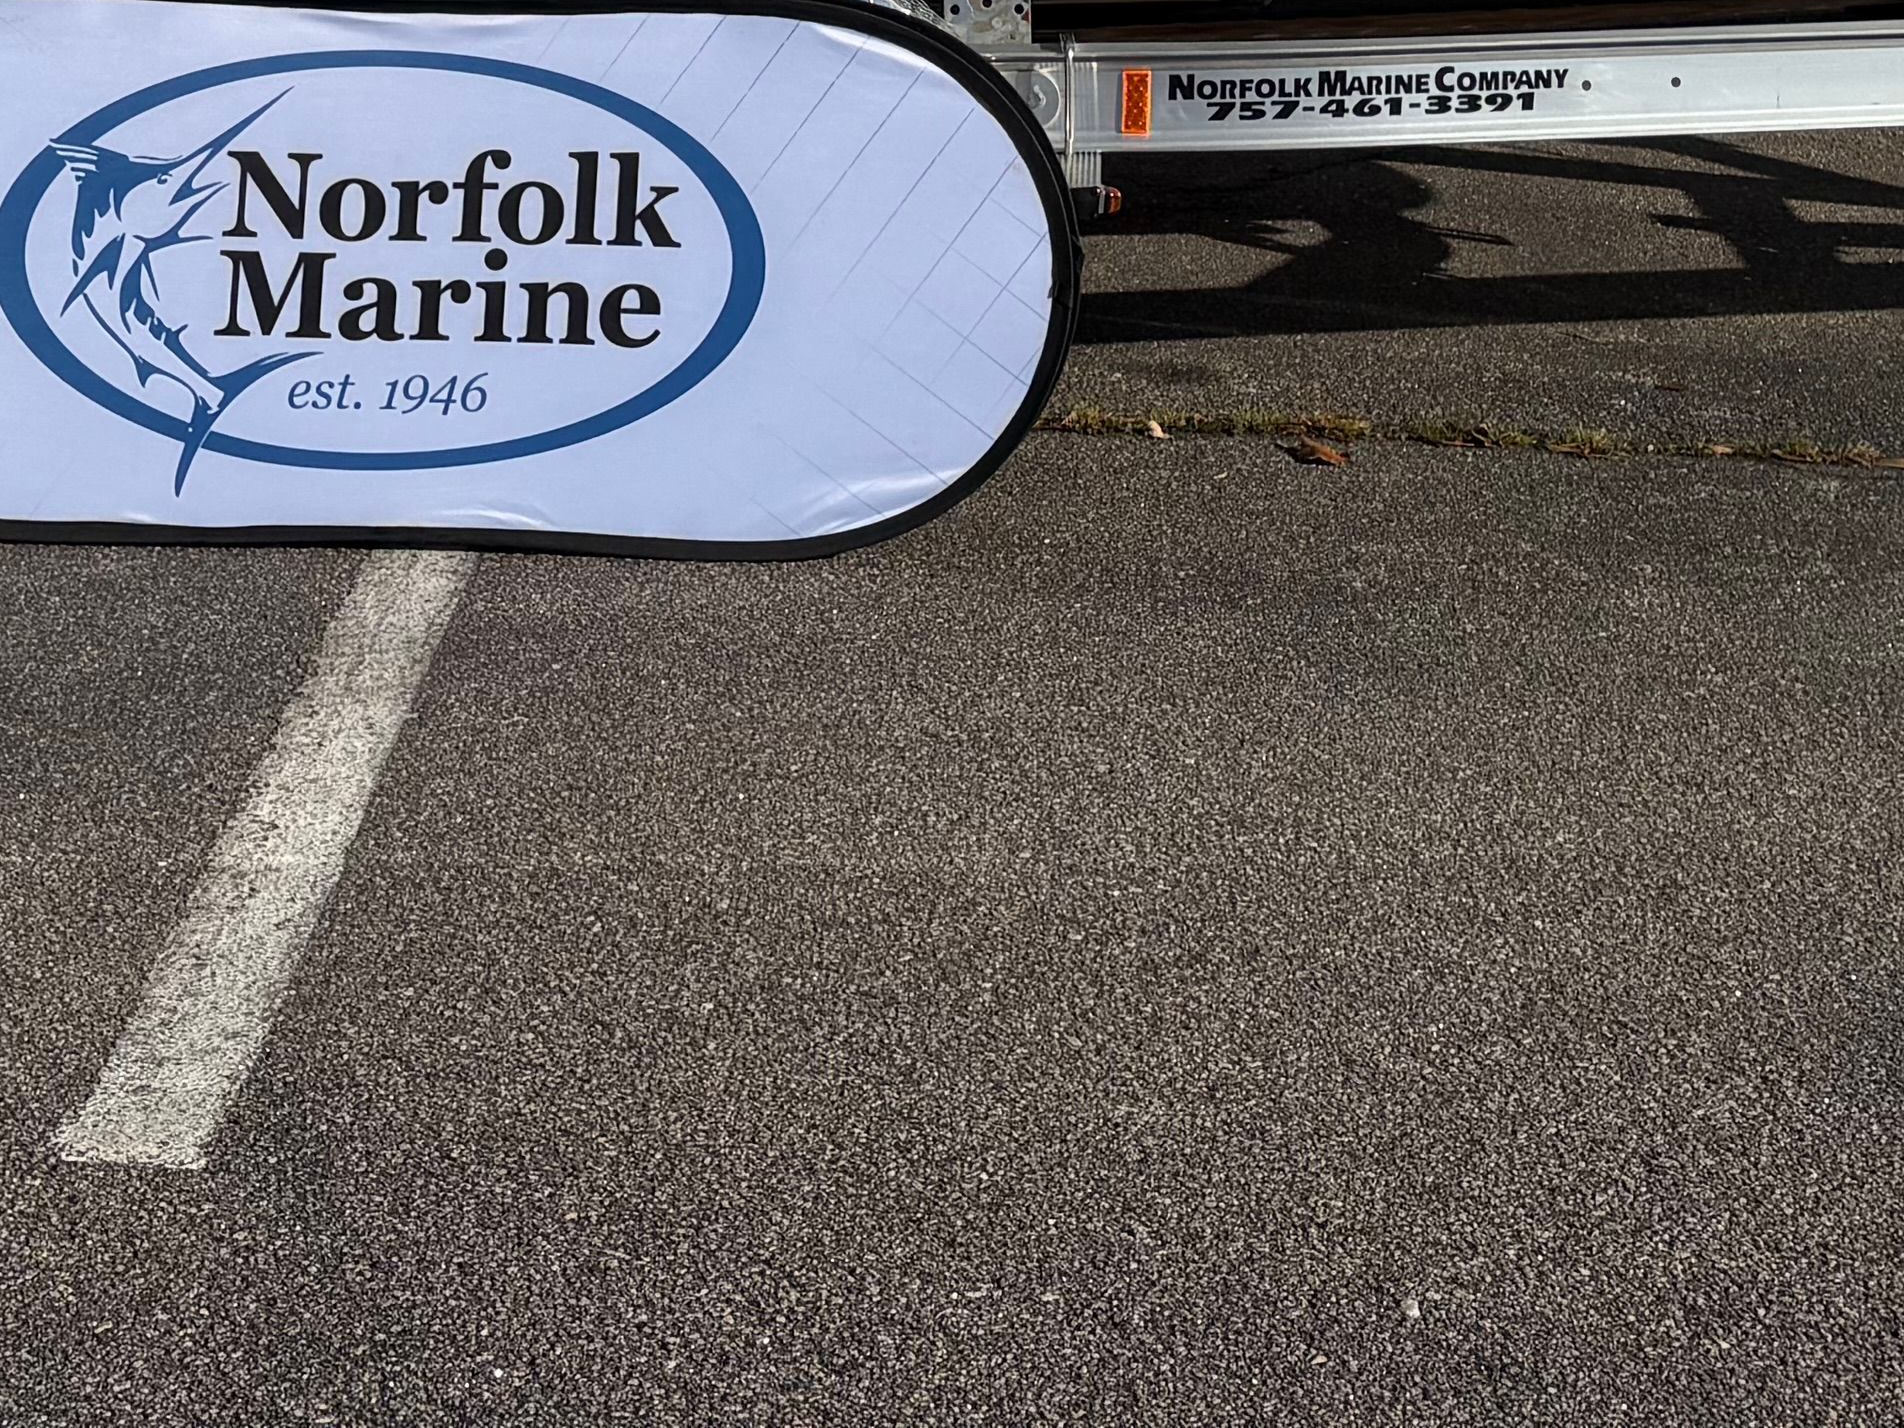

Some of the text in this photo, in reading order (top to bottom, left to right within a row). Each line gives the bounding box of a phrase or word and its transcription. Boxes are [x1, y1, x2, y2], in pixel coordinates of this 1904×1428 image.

[1168, 66, 1569, 101] NORFOLK MARINE COMPANY
[1207, 92, 1536, 122] 757-461-3391
[222, 149, 682, 248] Norfolk
[213, 248, 662, 348] Marine
[287, 373, 489, 416] est. 1946
